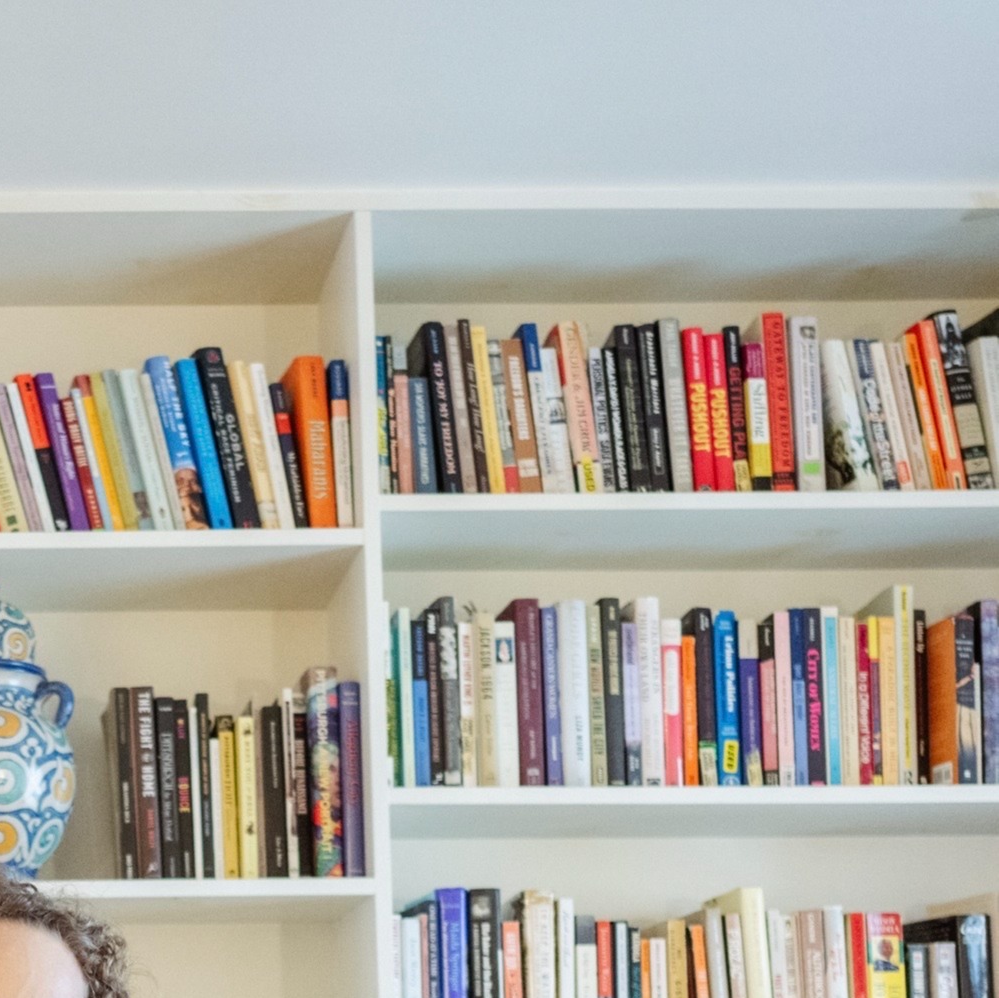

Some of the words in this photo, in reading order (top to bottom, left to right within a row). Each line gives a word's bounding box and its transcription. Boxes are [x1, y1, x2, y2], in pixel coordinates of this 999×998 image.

[433, 360, 443, 377] TO
[565, 328, 581, 382] GENDER
[645, 331, 658, 376] Grassroots
[772, 322, 784, 381] GATEWAY
[163, 361, 176, 392] HALF
[592, 359, 603, 396] PERSONAL
[174, 396, 186, 420] THE
[439, 403, 448, 420] MY
[575, 397, 586, 417] JIM
[650, 379, 662, 414] Warriors
[729, 366, 745, 429] GETTING
[752, 382, 766, 439] Shifting
[777, 387, 785, 403] TO
[178, 423, 190, 447] SKY
[596, 400, 608, 435] POLITICS
[689, 383, 710, 452] PUSHOUT
[709, 388, 730, 458] PUSHOUT
[212, 383, 224, 426] CRITICAL
[219, 429, 230, 454] RACE
[225, 457, 240, 503] FEMINISM
[225, 414, 245, 471] GLOBAL
[440, 421, 456, 475] FREEDOM
[579, 421, 592, 452] CROW
[600, 440, 611, 461] SARA
[778, 407, 791, 468] FREEDOM
[583, 463, 595, 492] USED
[602, 463, 614, 488] EVANS
[878, 443, 893, 481] Street
[724, 635, 735, 669] Urban
[806, 648, 820, 681] CITY
[725, 672, 737, 712] Politics
[858, 671, 868, 682] In
[137, 692, 151, 713] THE
[316, 670, 330, 745] PITTSBURGH
[858, 694, 871, 733] Different
[139, 717, 153, 749] FIGHT
[808, 703, 822, 752] WOMEN
[726, 744, 735, 770] USED
[861, 736, 872, 764] Voice
[141, 765, 156, 798] HOME
[320, 758, 331, 788] NEW
[178, 777, 190, 813] BOUNCE
[320, 792, 334, 853] PORTRAIT
[450, 923, 460, 951] Maida
[449, 954, 460, 993] Springer
